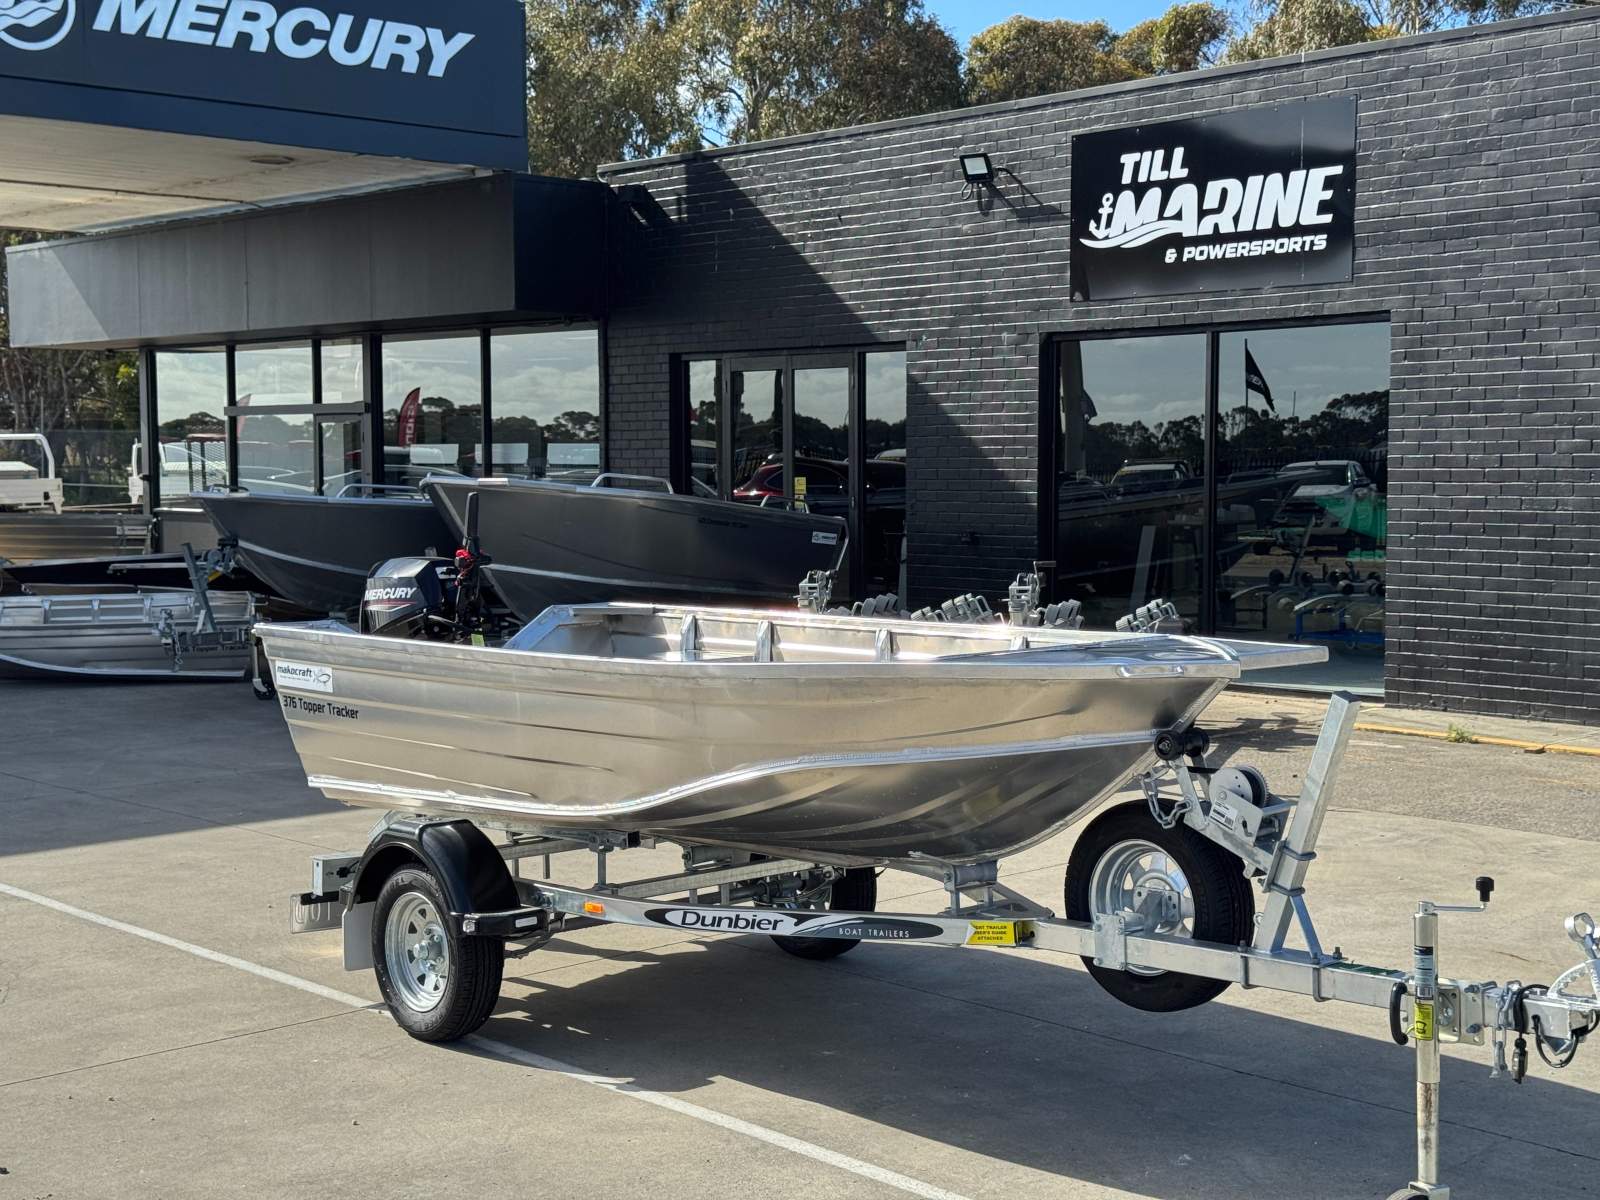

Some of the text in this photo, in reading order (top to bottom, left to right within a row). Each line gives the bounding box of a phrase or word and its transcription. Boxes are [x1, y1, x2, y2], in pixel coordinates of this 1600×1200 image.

[93, 0, 476, 78] MERCURY
[1120, 146, 1189, 185] TILL
[1108, 165, 1344, 239] MARINE
[1164, 234, 1328, 264] & POWERSPORTS
[364, 587, 418, 601] MERCURY
[277, 665, 313, 678] makocraft
[283, 695, 360, 719] 376 Topper Tracker
[681, 910, 784, 931] Dunbier
[838, 927, 910, 938] BOAT TRAILERS
